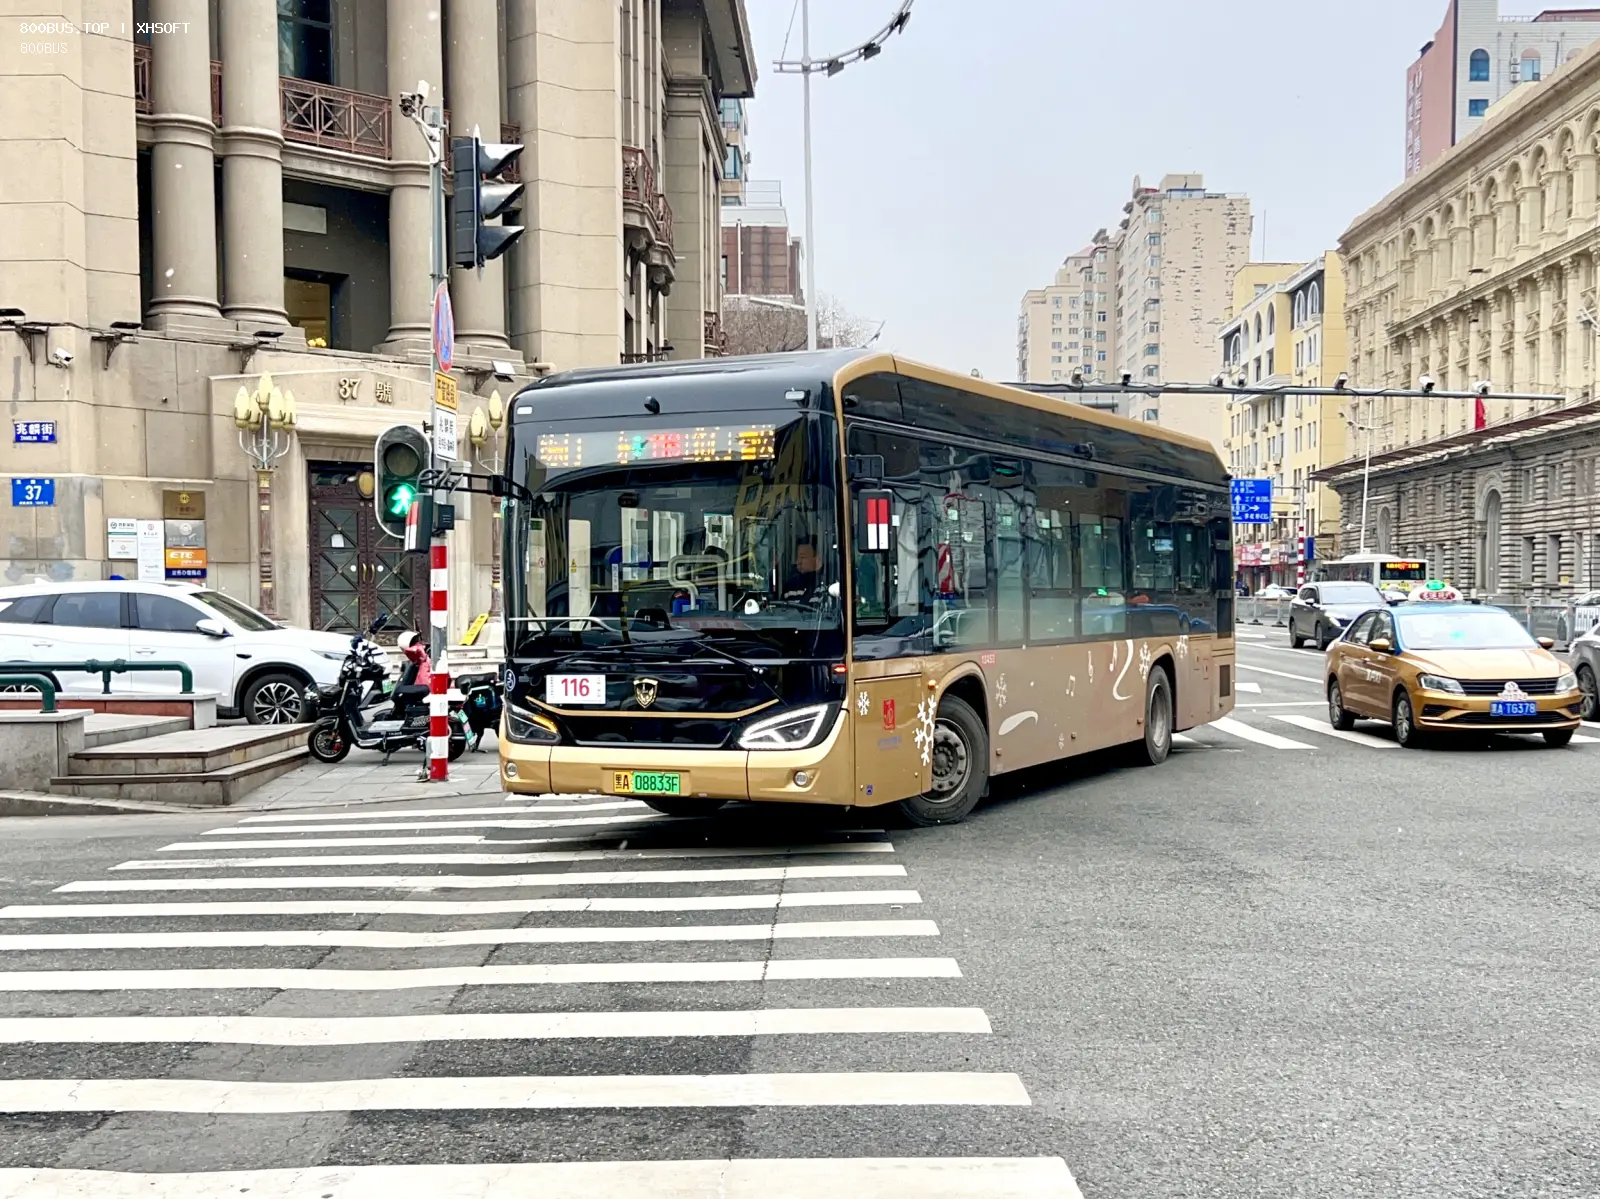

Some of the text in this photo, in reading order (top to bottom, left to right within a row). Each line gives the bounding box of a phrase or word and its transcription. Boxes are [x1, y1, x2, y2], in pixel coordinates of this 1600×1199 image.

[339, 377, 393, 403] 37 號
[25, 484, 42, 500] 37
[169, 551, 195, 559] ETC
[561, 677, 590, 697] 116
